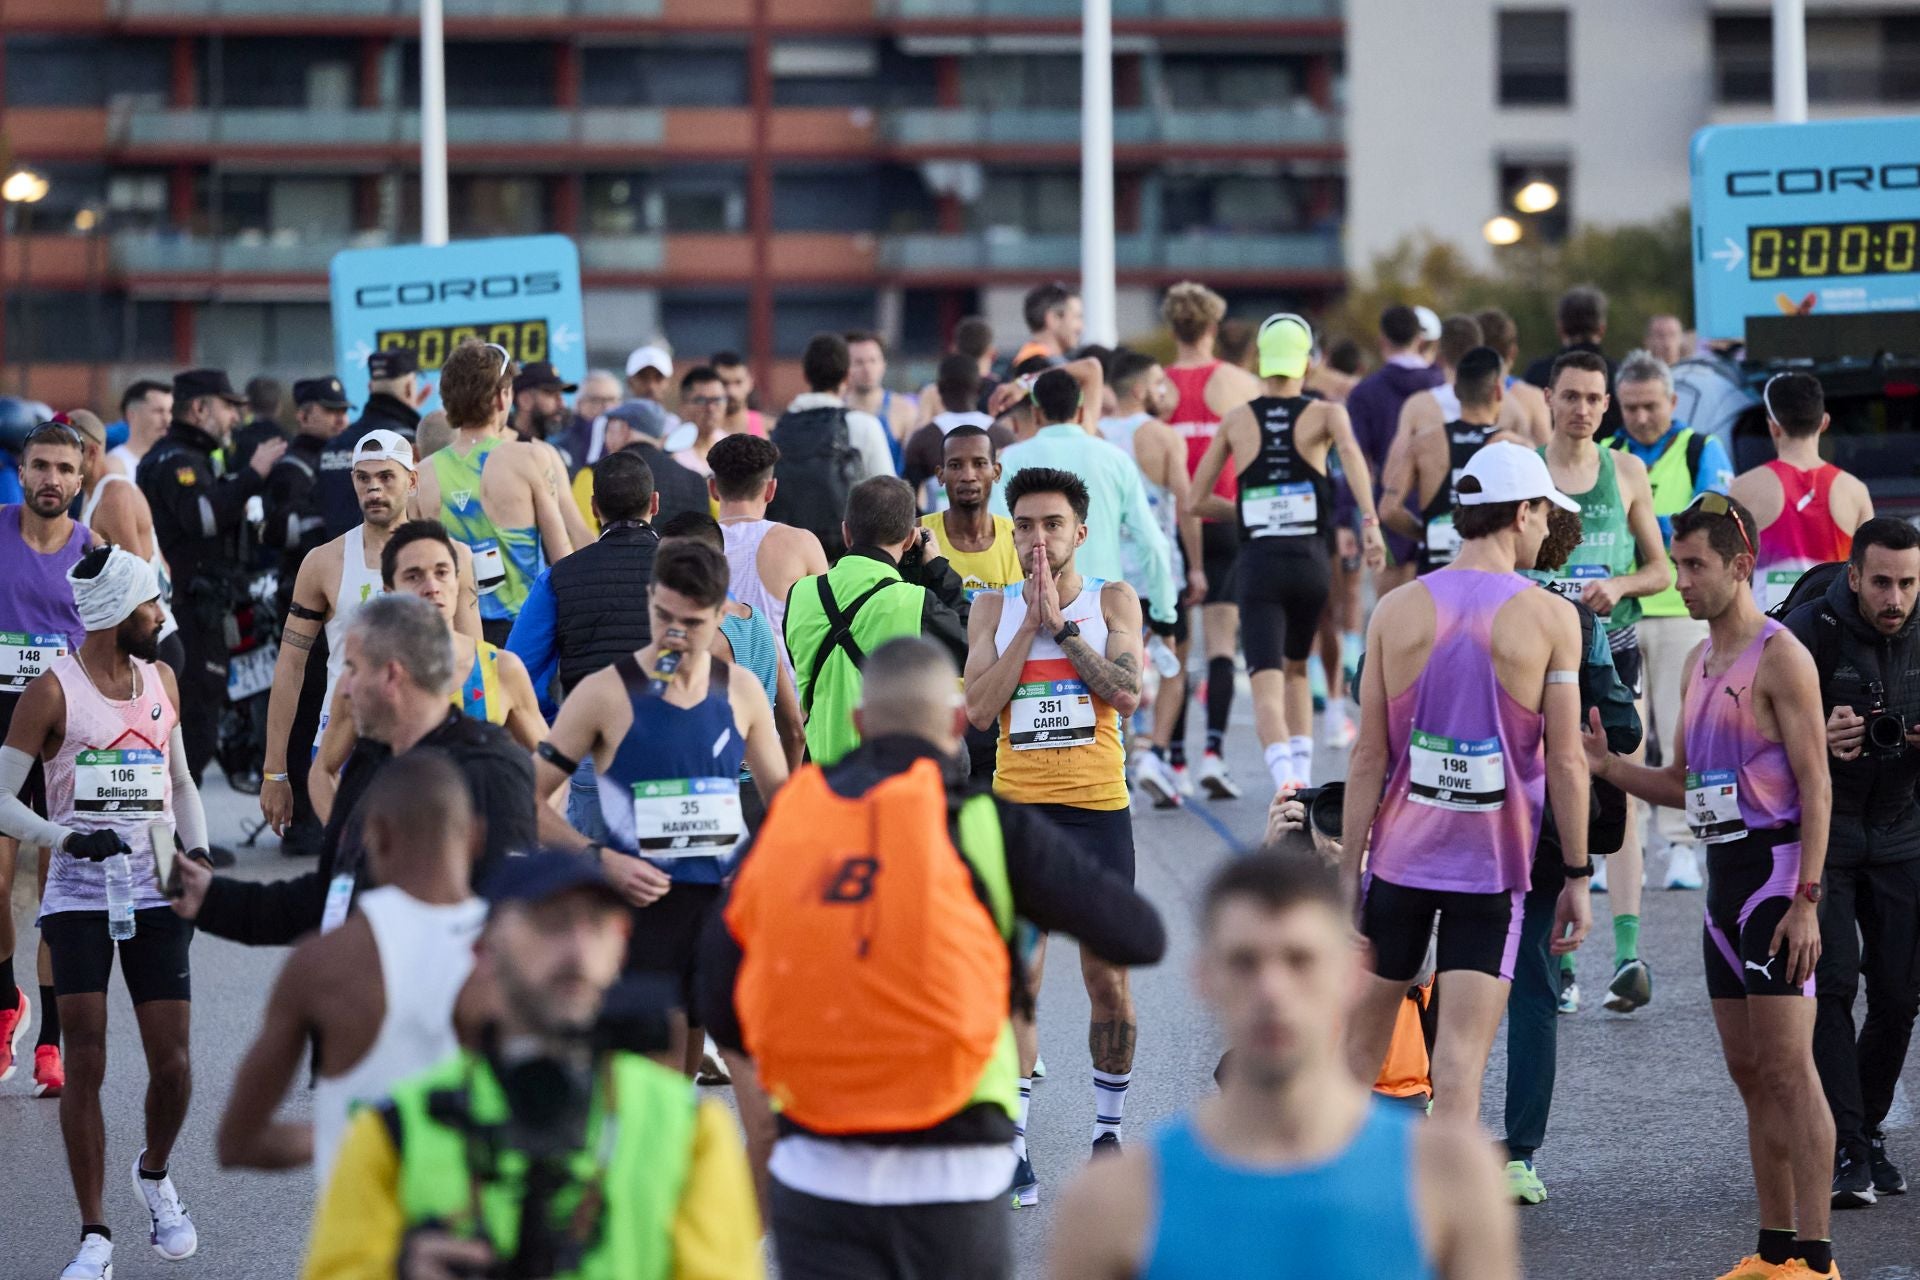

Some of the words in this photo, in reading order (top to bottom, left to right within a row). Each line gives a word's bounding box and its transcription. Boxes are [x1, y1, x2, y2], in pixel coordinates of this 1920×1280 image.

[356, 272, 562, 309] COROS
[18, 650, 41, 662] 148
[16, 665, 41, 675] João
[1039, 699, 1062, 714] 351
[1033, 715, 1070, 729] CARRO
[1442, 758, 1468, 773] 198
[111, 769, 135, 782] 106
[1438, 774, 1472, 790] ROWE
[97, 787, 148, 799] Belliappa
[680, 801, 700, 816] 35
[662, 820, 720, 833] HAWKINS
